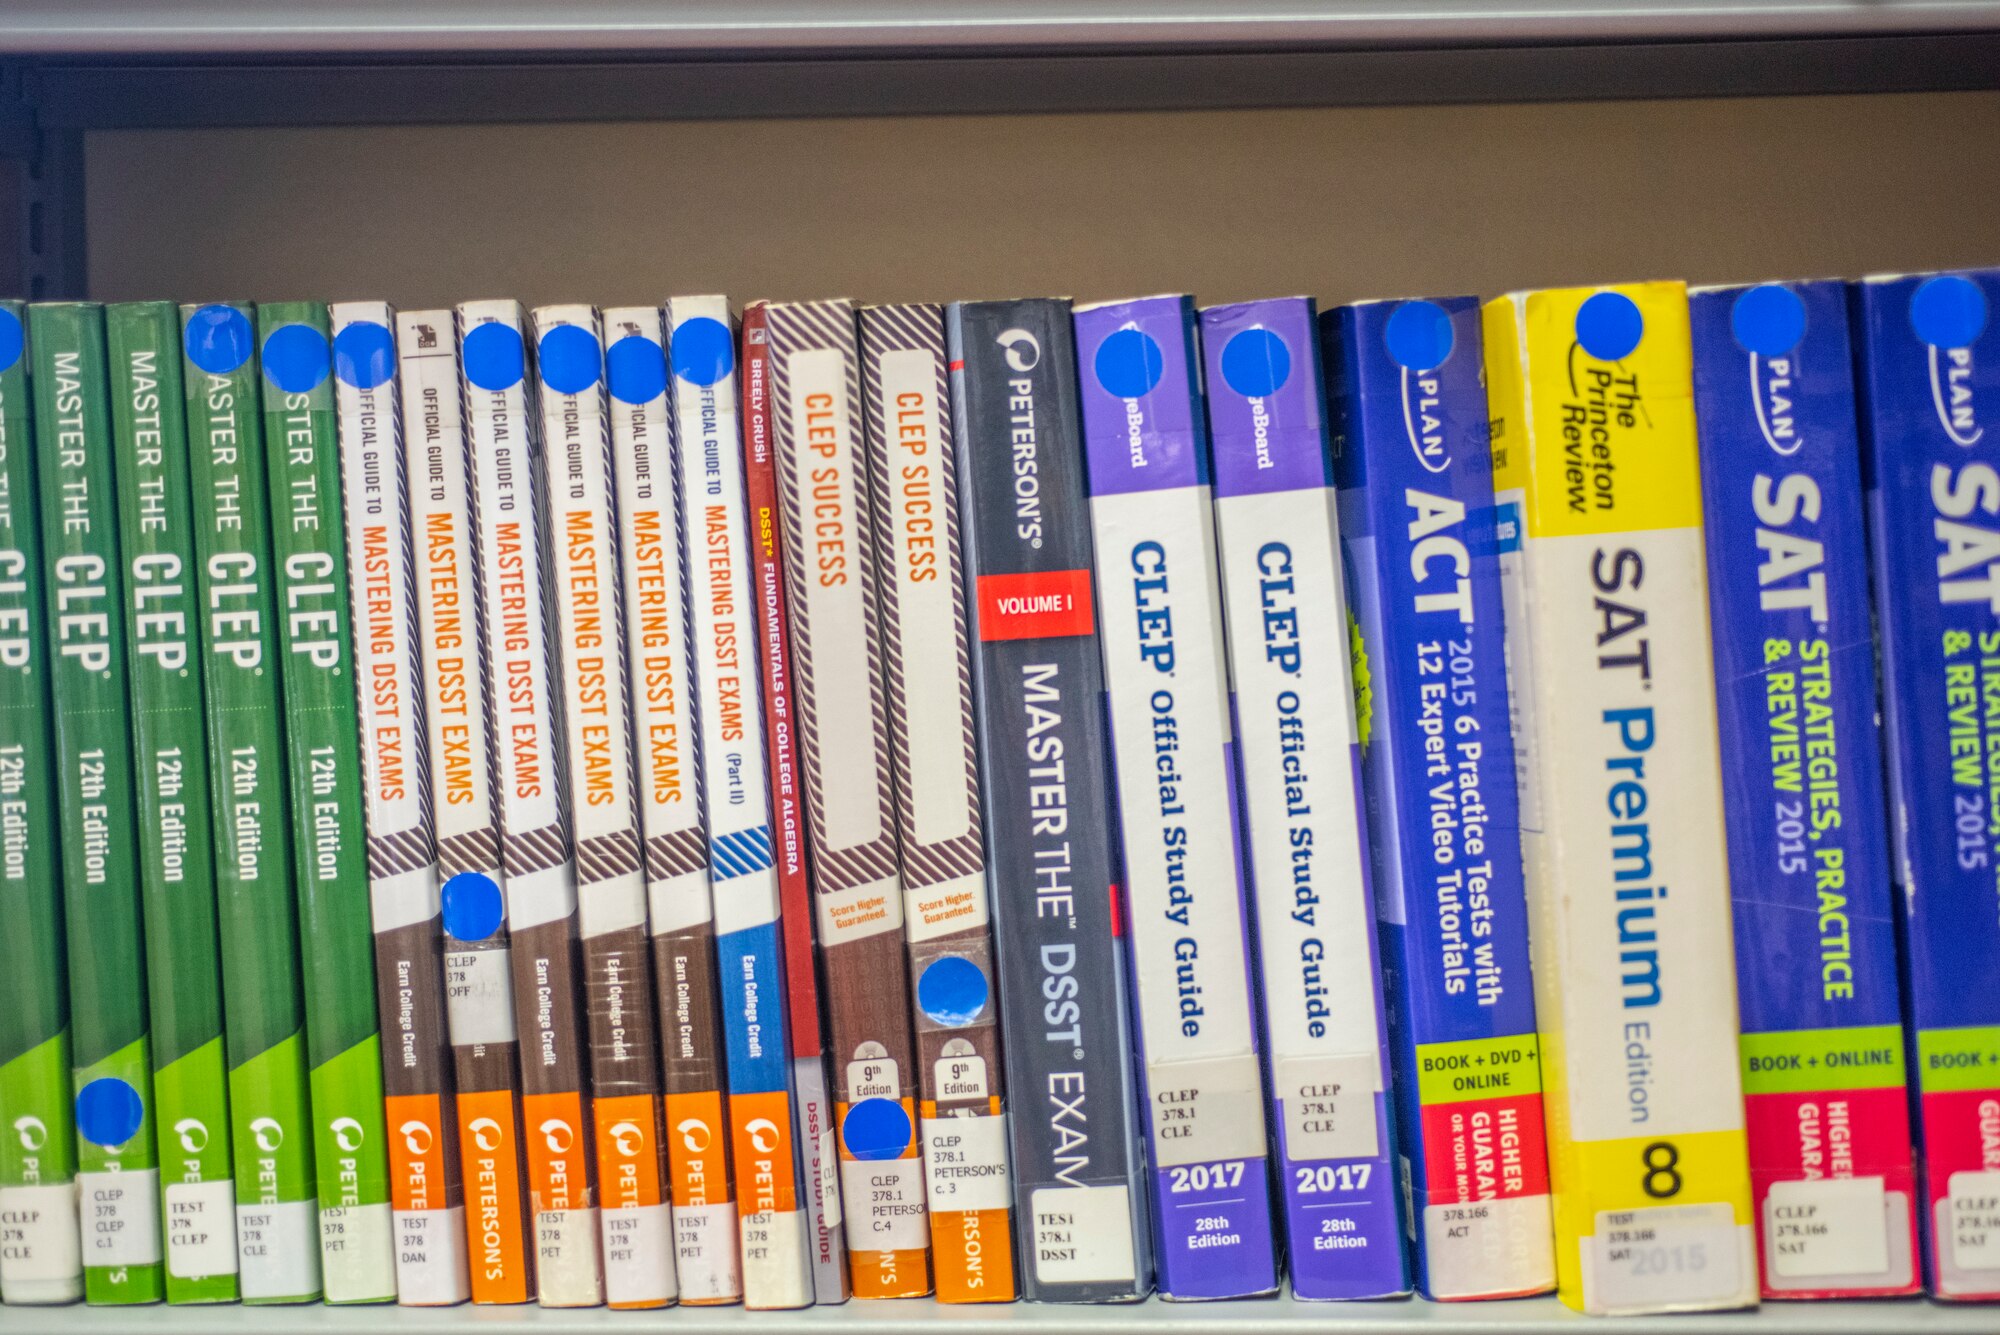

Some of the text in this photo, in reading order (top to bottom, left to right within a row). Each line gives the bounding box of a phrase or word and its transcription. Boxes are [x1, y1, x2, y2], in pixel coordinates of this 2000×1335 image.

[53, 352, 86, 468] MASTER
[131, 351, 162, 466] MASTER
[751, 358, 766, 463] BREELY CRUSH
[1417, 369, 1443, 456] PLAN
[1614, 373, 1641, 428] The
[1586, 367, 1615, 510] Princeton
[1561, 403, 1592, 514] Review
[805, 393, 847, 588] CLEP SUCCESS
[896, 392, 937, 582] CLEP SUCCESS
[62, 476, 90, 535] THE
[140, 475, 166, 533] THE
[215, 474, 241, 532] THE
[292, 474, 319, 533] THE
[704, 505, 736, 616] MASTERING
[423, 387, 474, 805] OFFICIAL GUIDE TO MASTERING DSST EXAMS
[998, 594, 1073, 615] VOLUME I
[763, 562, 784, 692] FUNDAMENTALS
[495, 522, 541, 800] MASTERING DSST EXAMS
[565, 510, 614, 806] MASTERING DSST EXAMS
[633, 510, 682, 805] MASTERING DSST EXAMS
[714, 622, 738, 669] DSST
[363, 526, 405, 801] MASTERING DSST EXAMS
[717, 677, 744, 742] EXAMS
[774, 697, 787, 718] OF
[776, 721, 793, 795] COLLEGE
[1022, 663, 1068, 837] MASTER
[1151, 689, 1185, 817] Official
[1276, 690, 1311, 817] Official
[1763, 638, 1807, 875] & REVIEW 2015
[726, 752, 742, 789] (Part
[1946, 664, 1988, 870] REVIEW 2015
[79, 748, 110, 884] 12th Edition
[156, 746, 187, 882] 12th Edition
[232, 745, 262, 881] 12th Edition
[310, 745, 341, 881] 12th Edition
[1416, 641, 1471, 996] 12 Expert Video Tutorials
[1447, 639, 1503, 1006] 2015 6 Practice Tests with
[1799, 639, 1854, 1000] STRATEGIES, PRACTICE
[782, 798, 799, 876] ALGEBRA
[1602, 706, 1668, 1010] Premium
[1162, 826, 1193, 926] Study
[1289, 827, 1320, 926] Study
[830, 895, 887, 918] Score Higher.
[835, 908, 888, 930] Guaranteed.
[446, 956, 477, 968] CLEP
[448, 972, 466, 982] 378
[449, 986, 471, 998] OFF
[1174, 937, 1205, 1038] Guide
[1300, 937, 1330, 1038] Guide
[742, 955, 762, 1058] Earn College Credit
[863, 1065, 881, 1082] 9th
[951, 1063, 969, 1079] 9th
[1423, 1050, 1522, 1072] BOOK DVD
[1624, 1020, 1654, 1124] Edition
[1749, 1049, 1894, 1072] BOOK ONLINE
[1929, 1053, 1982, 1069] BOOK
[856, 1084, 892, 1097] Edition
[944, 1082, 979, 1095] Edition
[1158, 1089, 1199, 1104] CLEP
[1453, 1073, 1511, 1091] ONLINE
[1162, 1108, 1196, 1121] 378.1
[933, 1136, 962, 1148] CLEP
[1161, 1125, 1193, 1139] CLE
[934, 1152, 965, 1163] 378.1
[1498, 1109, 1523, 1193] HIGHER
[871, 1175, 900, 1187] CLEP
[934, 1164, 1006, 1178] PETERSON'S
[1169, 1162, 1245, 1193] 2017
[1295, 1164, 1372, 1193] 2017
[1641, 1141, 1683, 1199] 8
[94, 1189, 124, 1202] CLEP
[95, 1205, 117, 1217] 378
[171, 1201, 206, 1214] TEST
[872, 1190, 903, 1202] 378.1
[95, 1220, 125, 1233] CLEP
[171, 1217, 192, 1229] 378
[324, 1223, 345, 1235] 378
[402, 1218, 428, 1229] TEST
[478, 1158, 504, 1280] PETERSON'S
[540, 1212, 566, 1223] TEST
[873, 1221, 892, 1232] C.4
[1195, 1216, 1229, 1231] 28th
[1321, 1218, 1356, 1232] 28th
[1443, 1207, 1488, 1222] 378.166
[96, 1237, 113, 1249] c.1
[172, 1233, 208, 1246] CLEP
[325, 1240, 345, 1252] PET
[403, 1236, 424, 1246] 378
[540, 1230, 561, 1240] 378
[1187, 1233, 1240, 1249] Edition
[1314, 1235, 1367, 1250] Edition
[1448, 1226, 1470, 1239] ACT
[402, 1253, 426, 1263] DAN
[541, 1247, 561, 1257] PET
[1040, 1249, 1077, 1261] DSST
